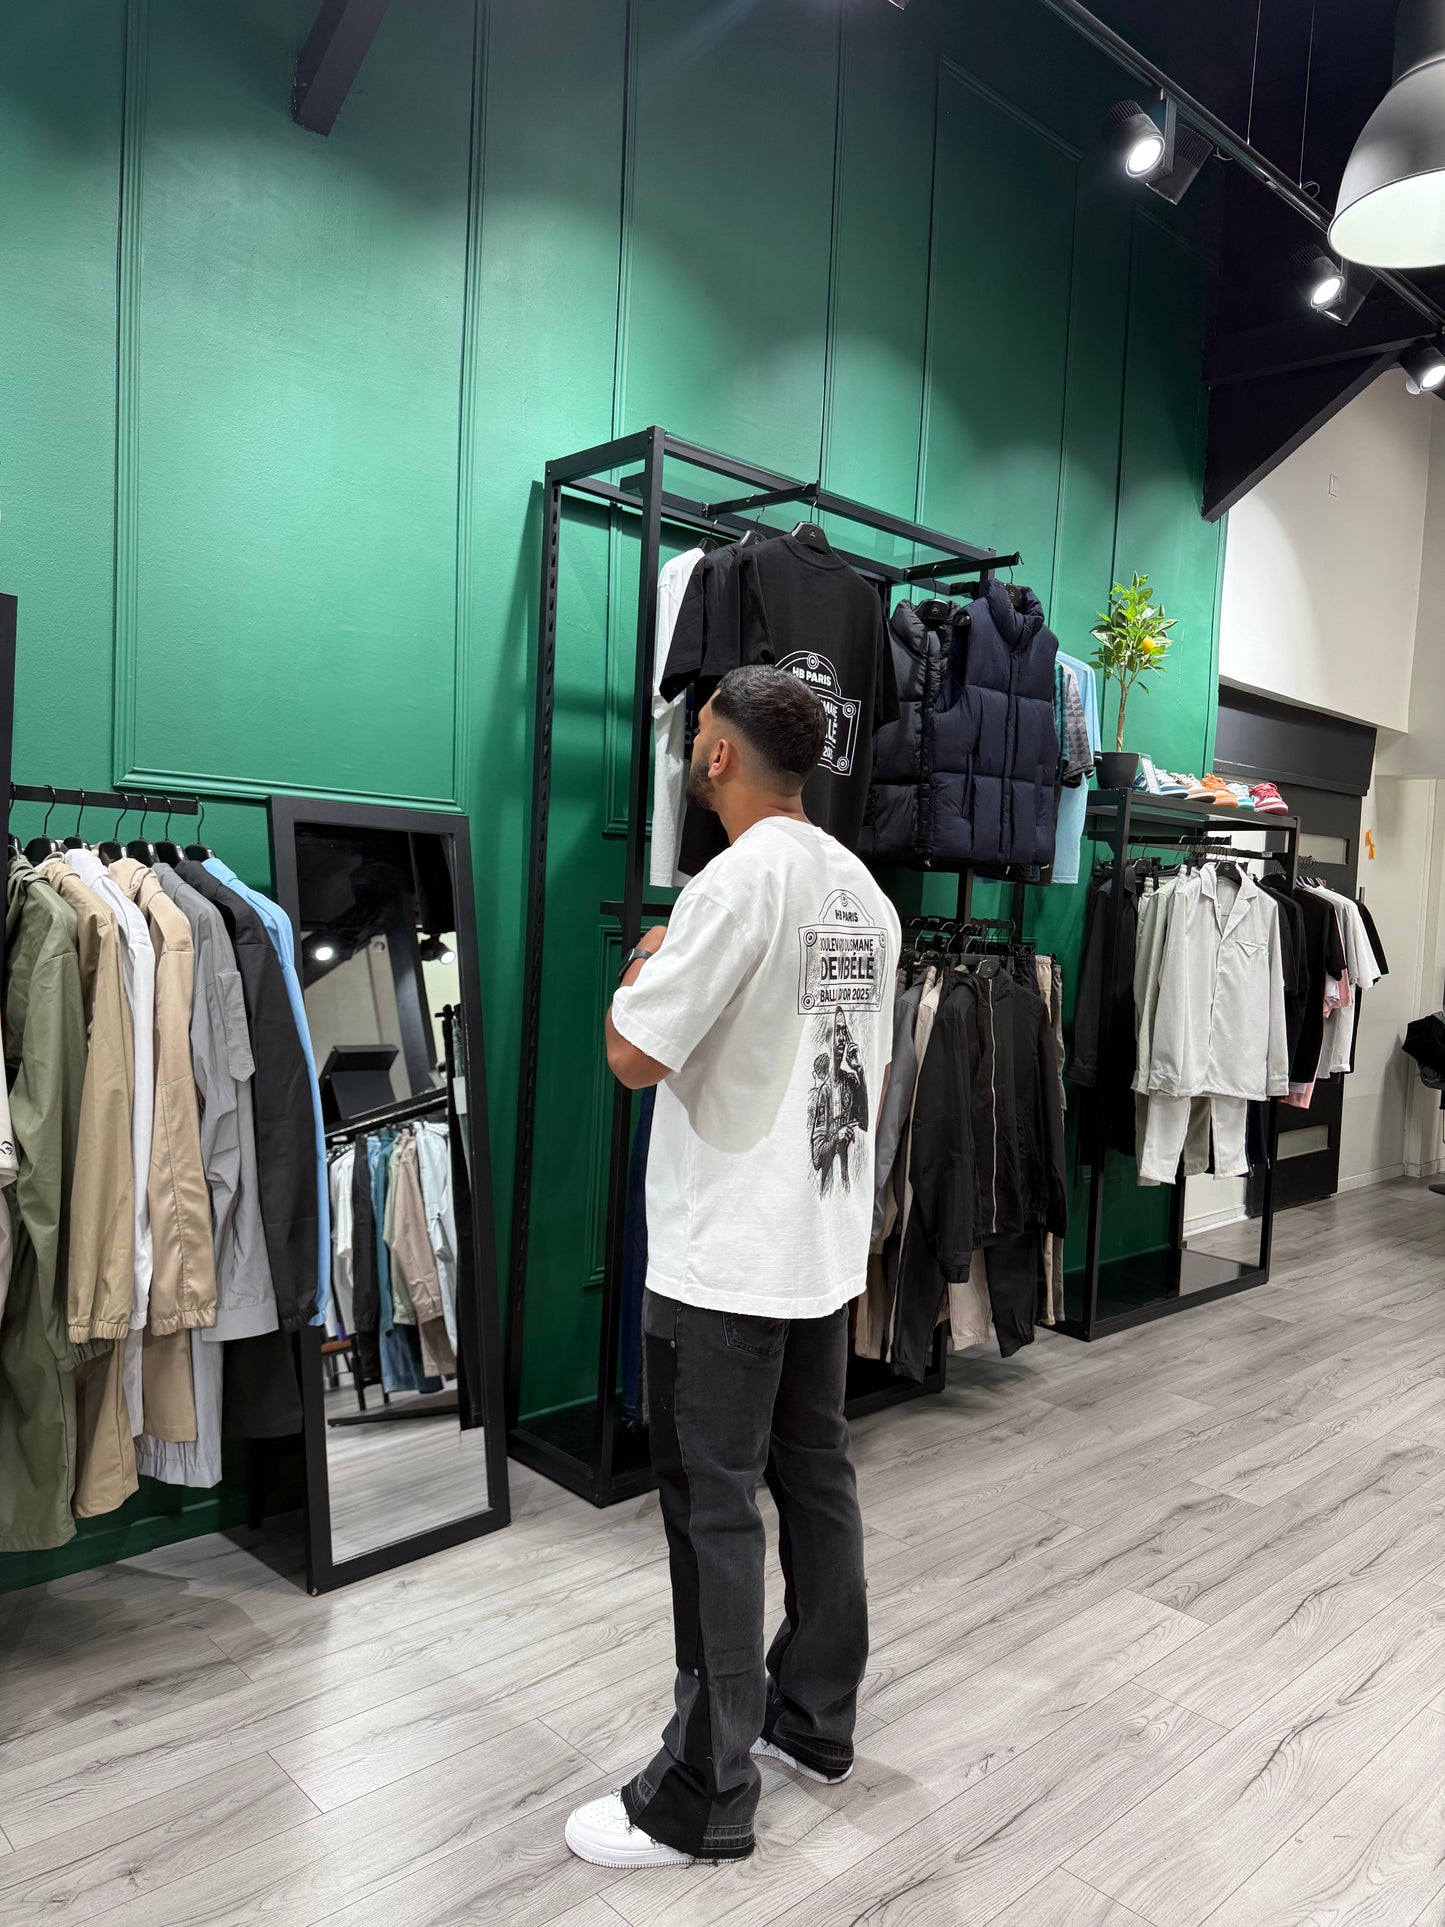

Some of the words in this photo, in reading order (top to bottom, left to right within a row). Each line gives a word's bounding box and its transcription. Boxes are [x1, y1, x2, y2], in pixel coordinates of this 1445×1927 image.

[792, 666, 805, 679] HB
[806, 670, 832, 687] PARIS
[842, 911, 859, 922] PARIS
[852, 987, 870, 1000] 2025
